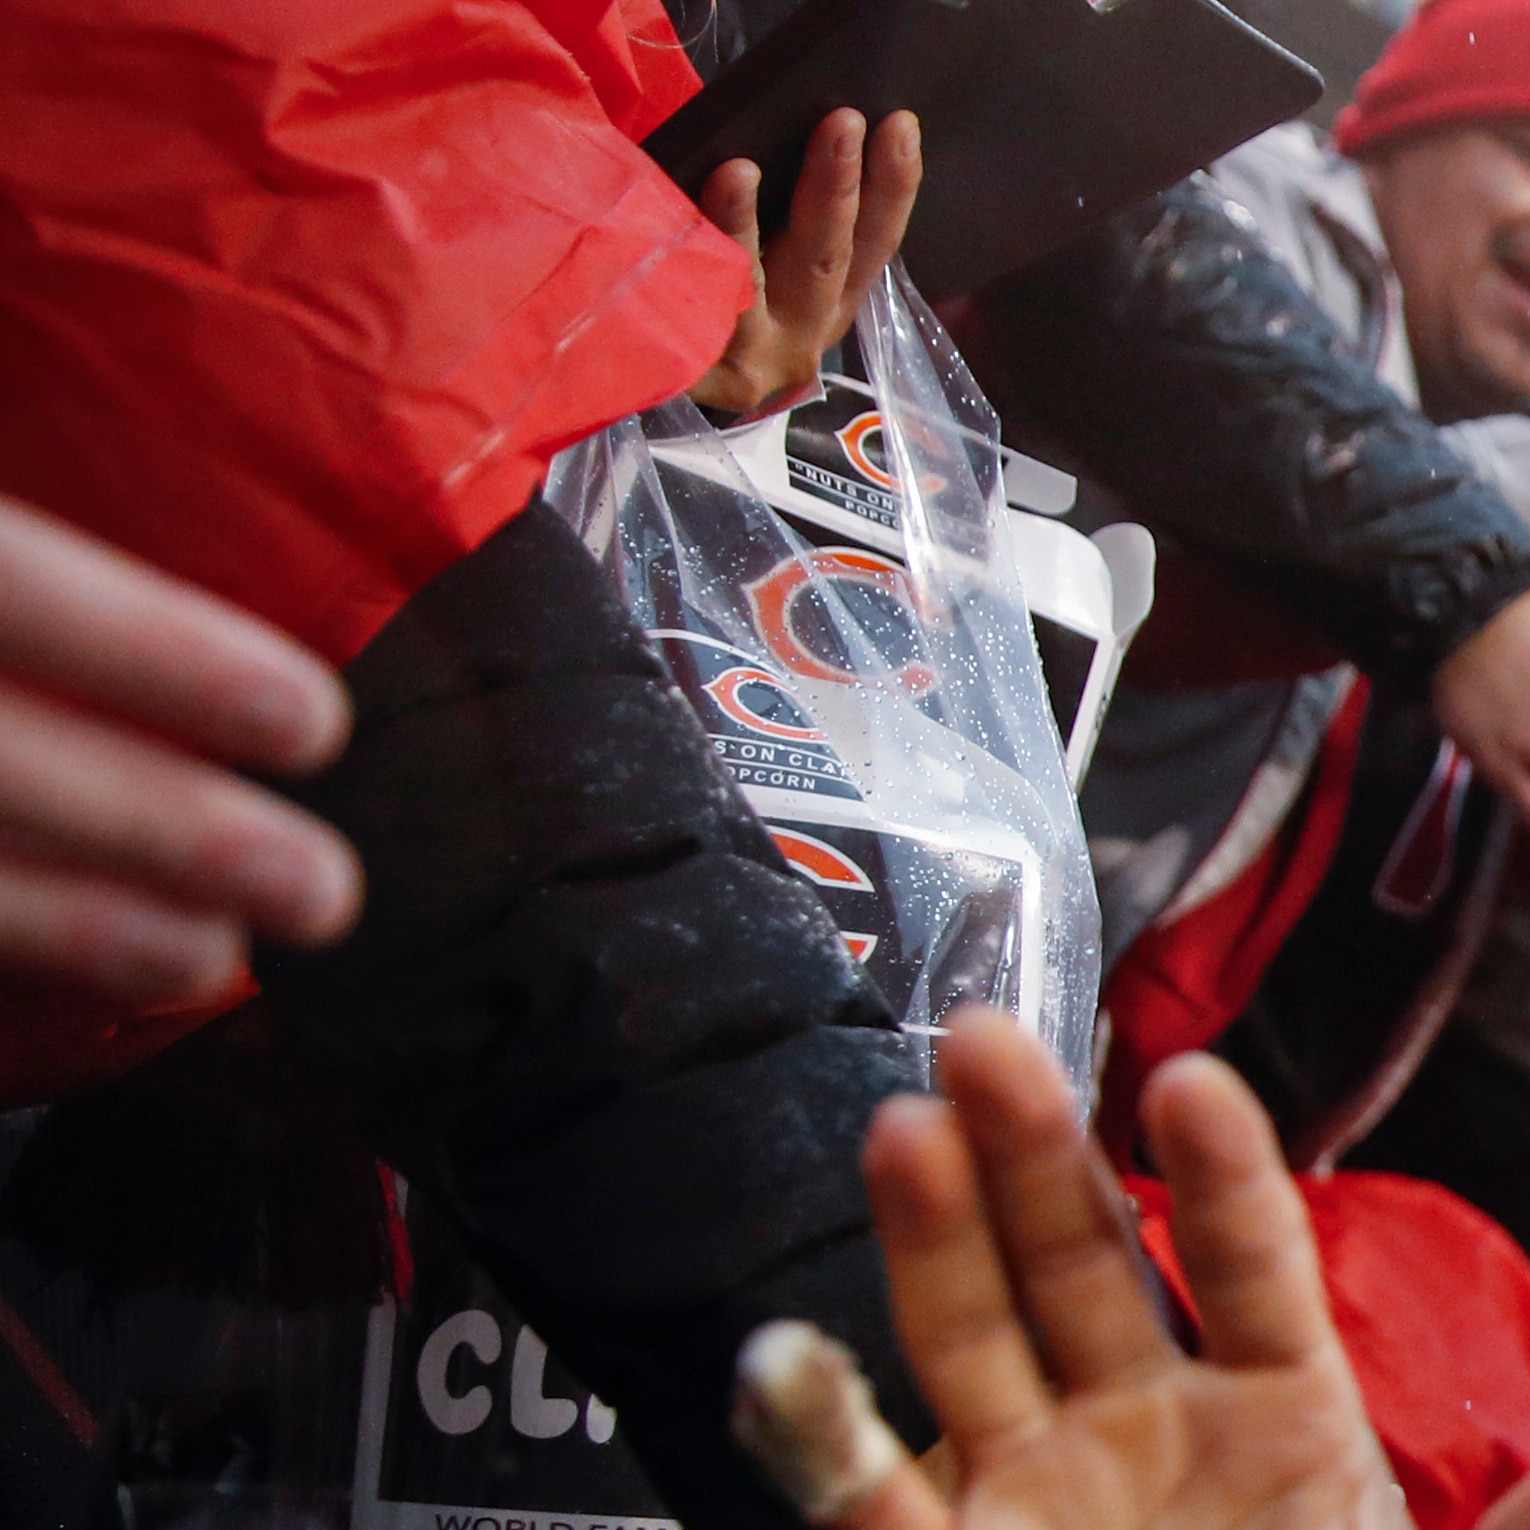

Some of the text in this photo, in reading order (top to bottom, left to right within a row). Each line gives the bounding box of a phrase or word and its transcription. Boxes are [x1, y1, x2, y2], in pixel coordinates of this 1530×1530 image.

[866, 491, 895, 511] ON
[740, 744, 775, 762] ON
[725, 765, 816, 790] OPCORN
[417, 1309, 617, 1444] CL
